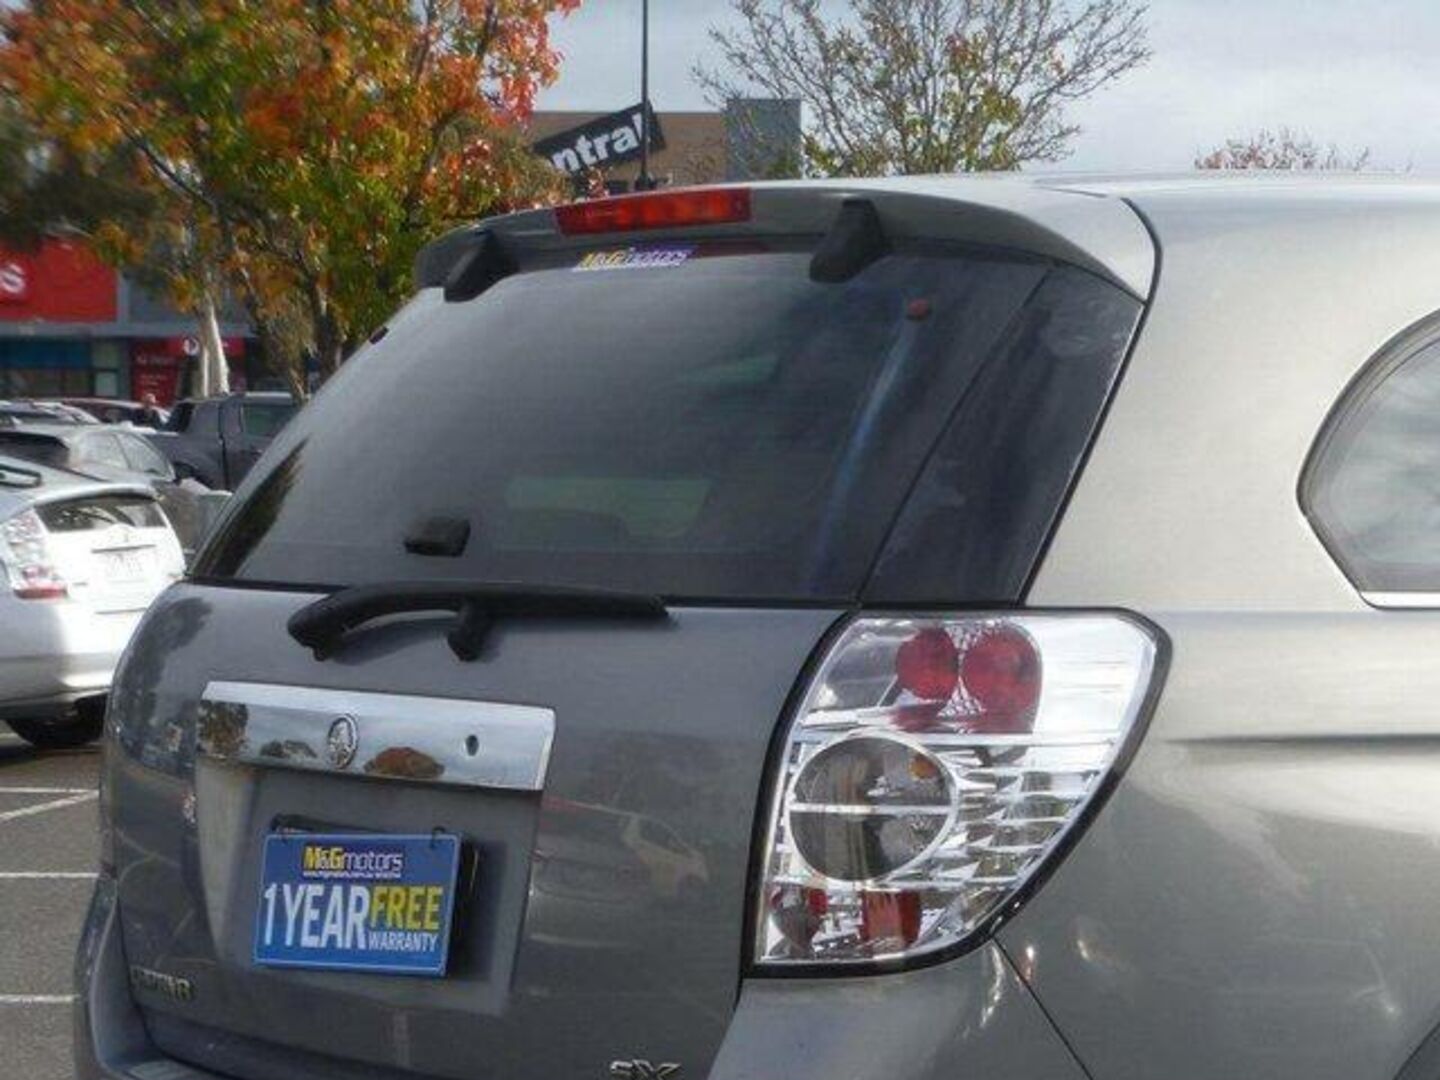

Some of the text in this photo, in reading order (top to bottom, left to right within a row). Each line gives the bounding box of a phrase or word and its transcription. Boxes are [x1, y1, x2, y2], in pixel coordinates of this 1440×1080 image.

[264, 882, 443, 950] 1 YEAR FREE
[367, 930, 438, 952] WARRANTY
